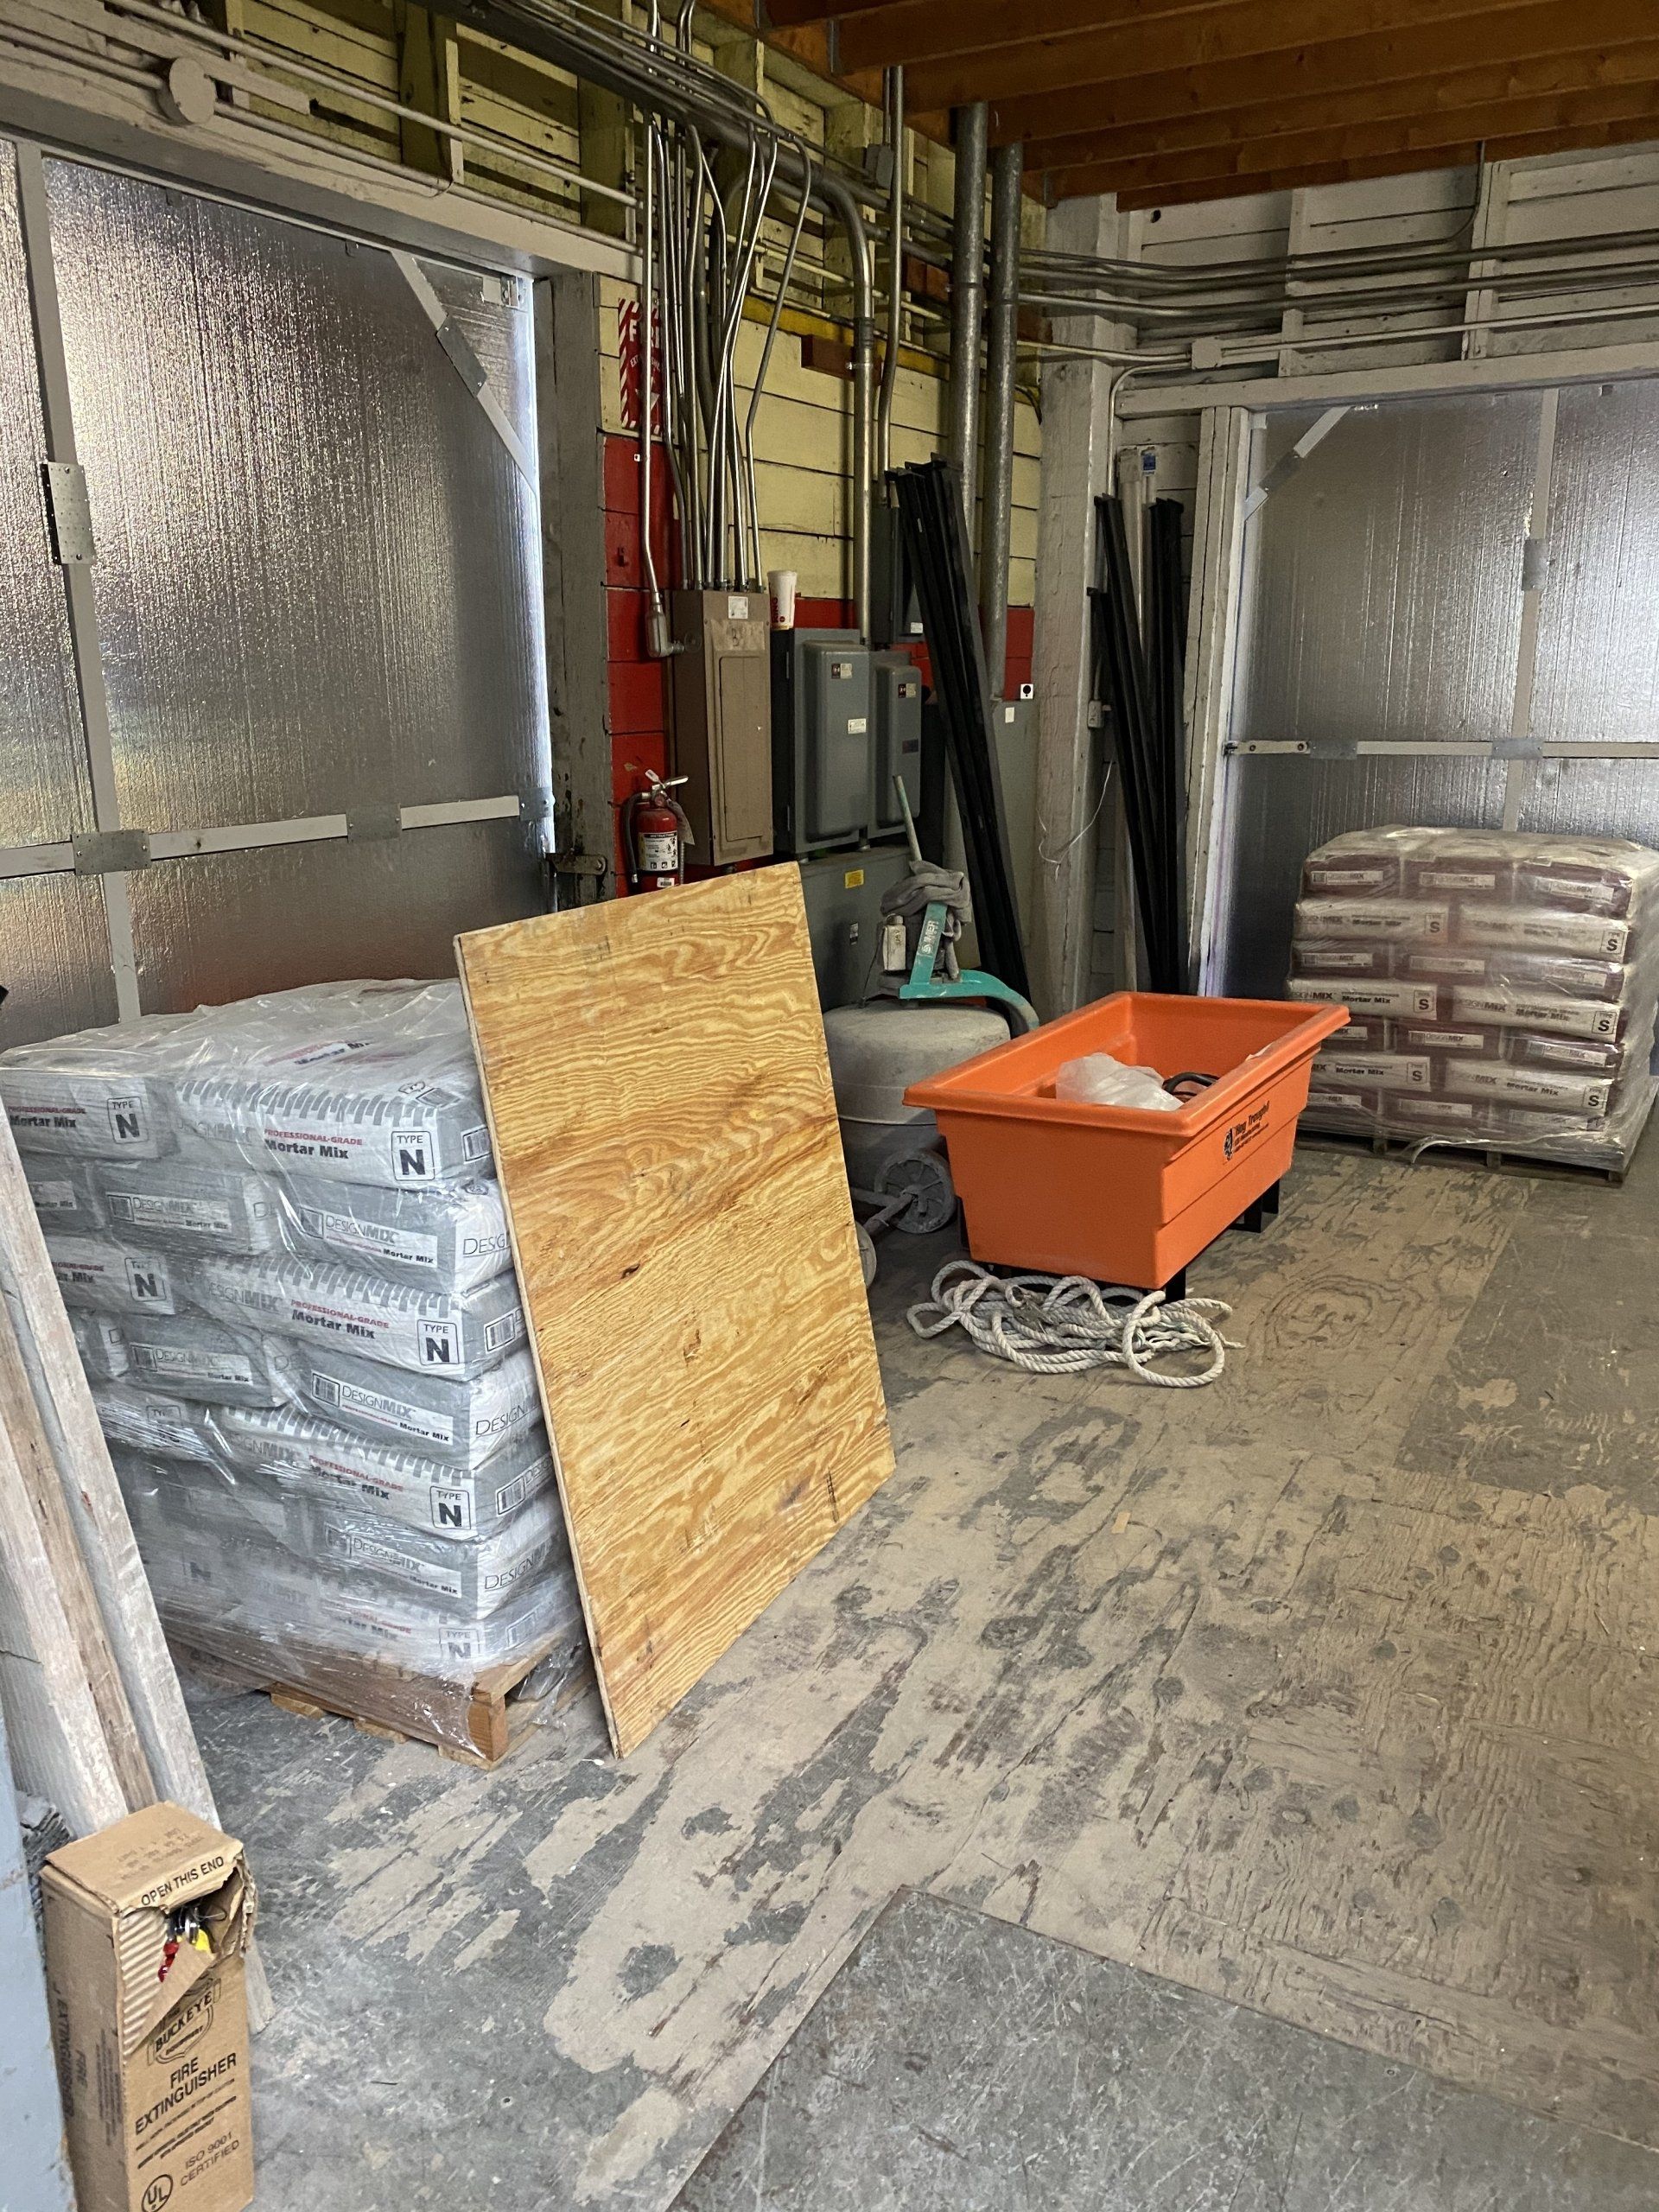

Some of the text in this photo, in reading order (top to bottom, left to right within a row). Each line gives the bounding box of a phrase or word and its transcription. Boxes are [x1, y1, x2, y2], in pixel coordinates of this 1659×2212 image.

[1429, 921, 1440, 933] S
[1605, 938, 1618, 951] S
[1418, 998, 1430, 1010] S
[1598, 1020, 1610, 1032] S
[1336, 1066, 1365, 1075] Mortar
[1412, 1070, 1423, 1082] S
[1541, 1088, 1559, 1096] Mix
[1588, 1095, 1599, 1107] S
[112, 1101, 135, 1110] TYPE
[54, 1116, 76, 1128] Mix
[116, 1114, 140, 1139] N
[264, 1128, 363, 1146] PROFESSIONAL-GRADE
[397, 1135, 423, 1144] TYPE
[264, 1139, 349, 1160] Mortar Mix
[399, 1149, 426, 1175] N
[384, 1248, 413, 1262] Mortar
[415, 1255, 435, 1265] Mix
[135, 1274, 158, 1296] N
[292, 1309, 375, 1339] Mortar Mix
[424, 1323, 449, 1334] TYPE
[425, 1337, 450, 1363] N
[341, 1385, 413, 1420] DESIGNMIX
[399, 1421, 429, 1436] Mortar
[432, 1431, 449, 1442] Mix
[361, 1484, 390, 1500] Mix
[436, 1491, 461, 1501] TYPE
[438, 1503, 462, 1527] N
[448, 1643, 472, 1659] N
[141, 1856, 224, 1906] OPEN THIS END
[156, 1991, 213, 2052] BUCKEYE
[170, 2056, 199, 2089] FIRE
[136, 2052, 238, 2136] EXTINGUISHER
[185, 2131, 232, 2170] ISO 9001
[181, 2139, 239, 2187] CERTIFIED
[147, 2184, 168, 2205] UL
